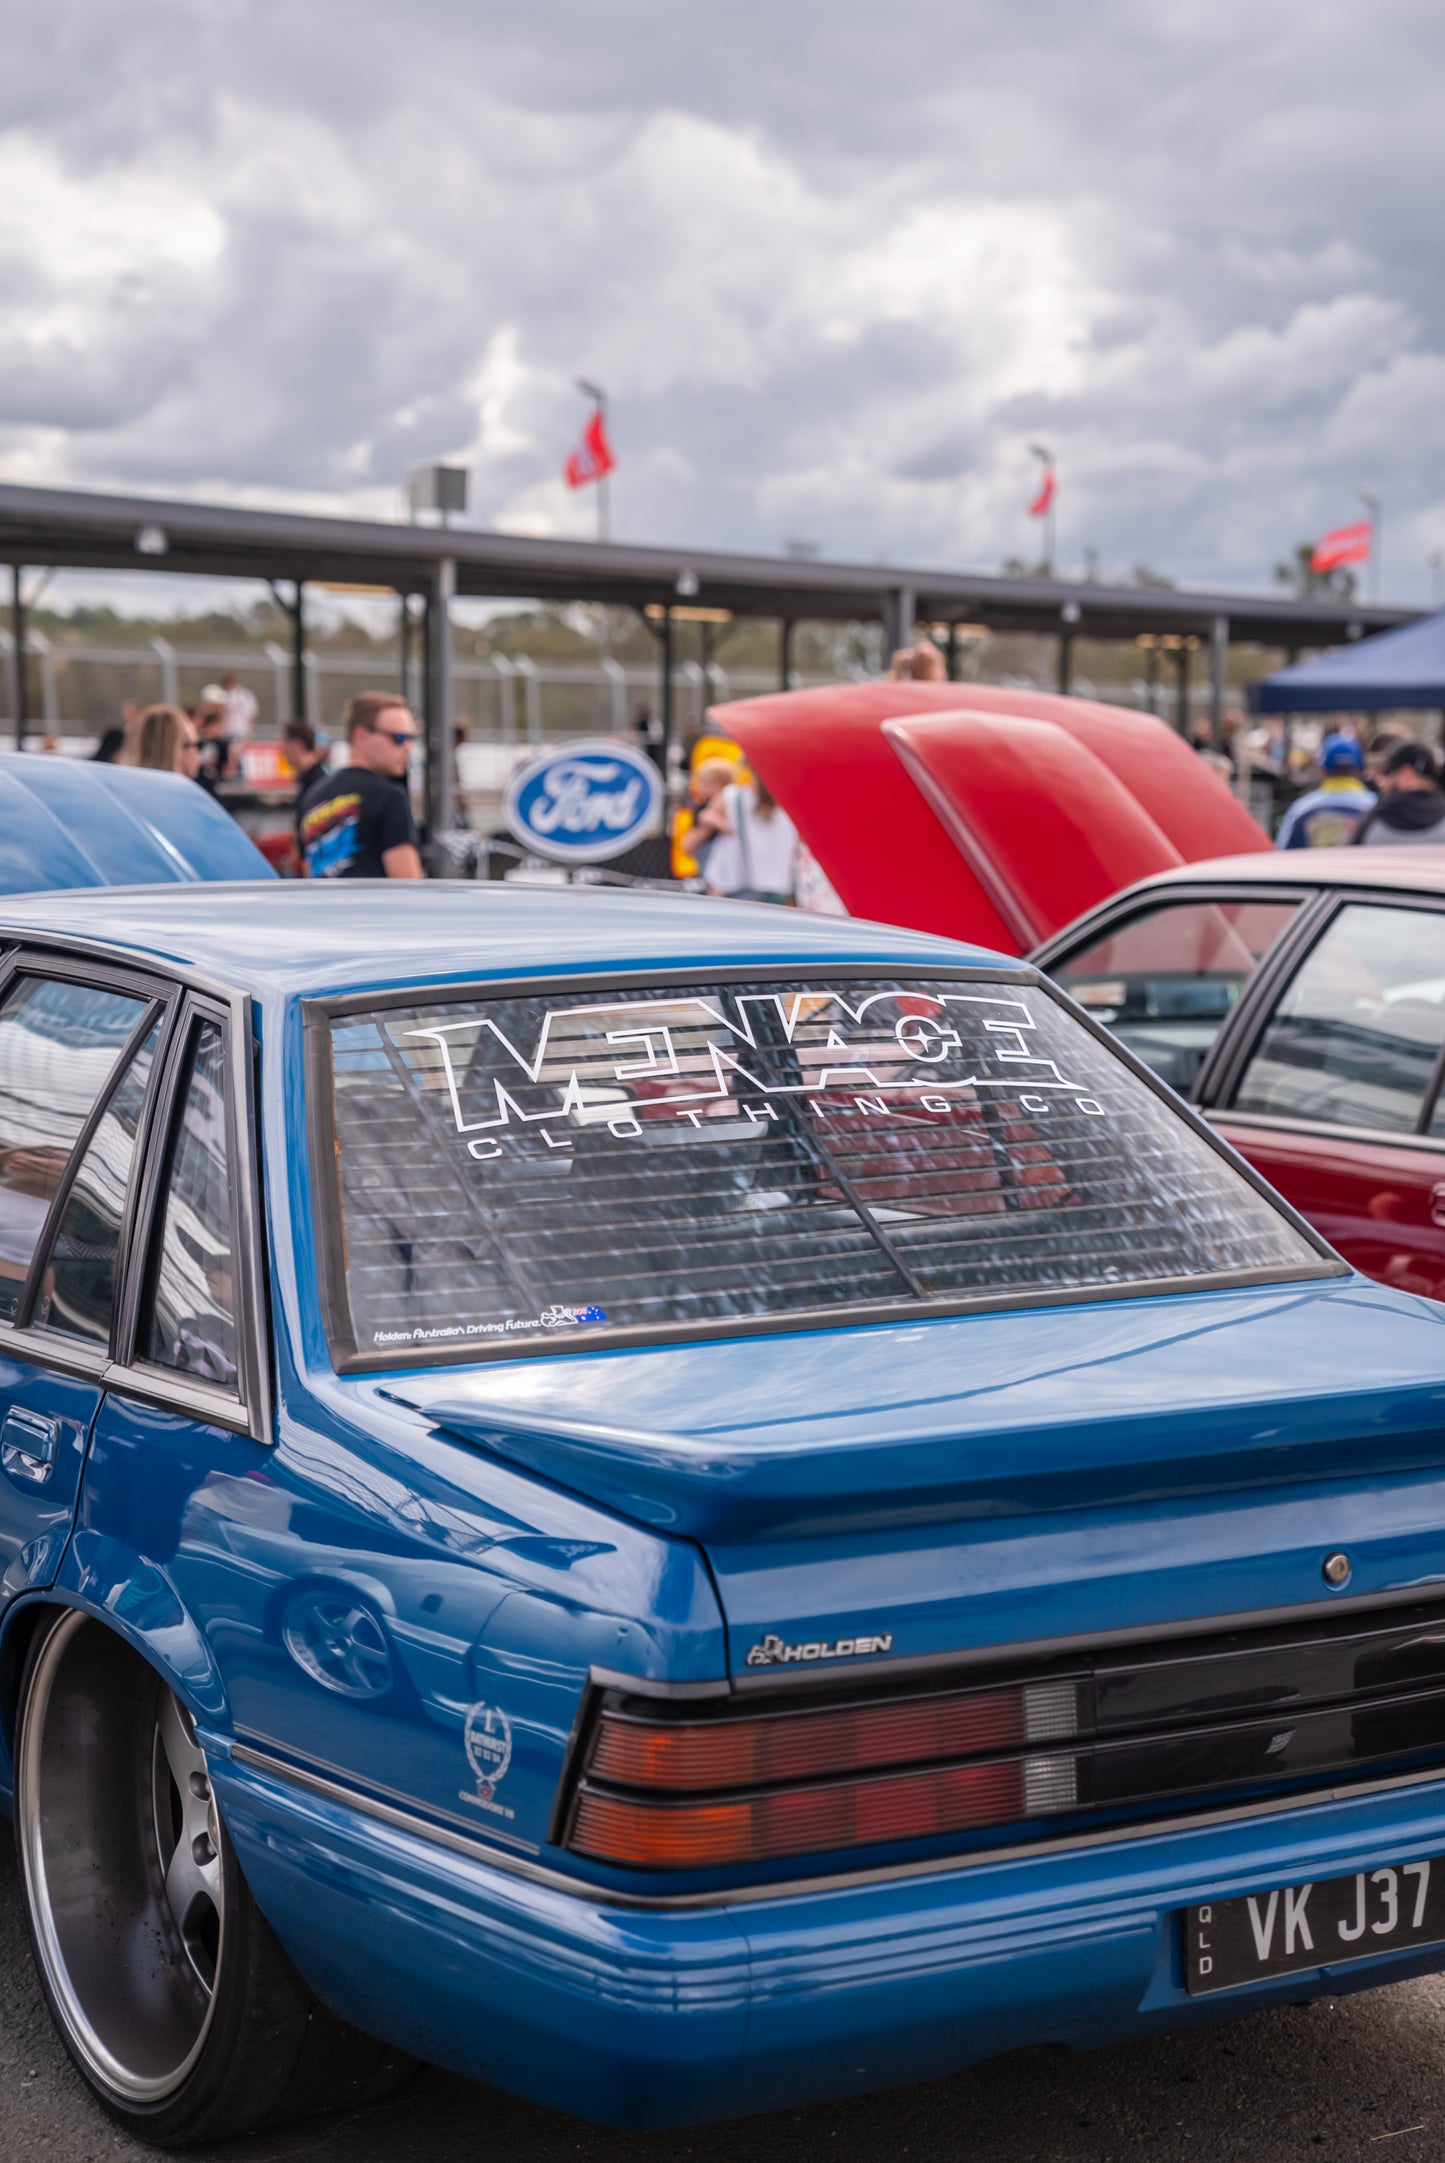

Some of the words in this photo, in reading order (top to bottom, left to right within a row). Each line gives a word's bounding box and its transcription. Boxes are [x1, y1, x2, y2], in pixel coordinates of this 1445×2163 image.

[529, 760, 643, 834] Ford
[402, 990, 1089, 1133] MENACE
[467, 1095, 952, 1160] CLOTHING
[1019, 1094, 1105, 1116] CO
[466, 1322, 504, 1335] Driving
[505, 1318, 542, 1330] Future.
[783, 1634, 893, 1662] HOLDEN
[1199, 1905, 1213, 1975] QLD
[1246, 1883, 1315, 1961] VK
[1337, 1860, 1431, 1942] J37
